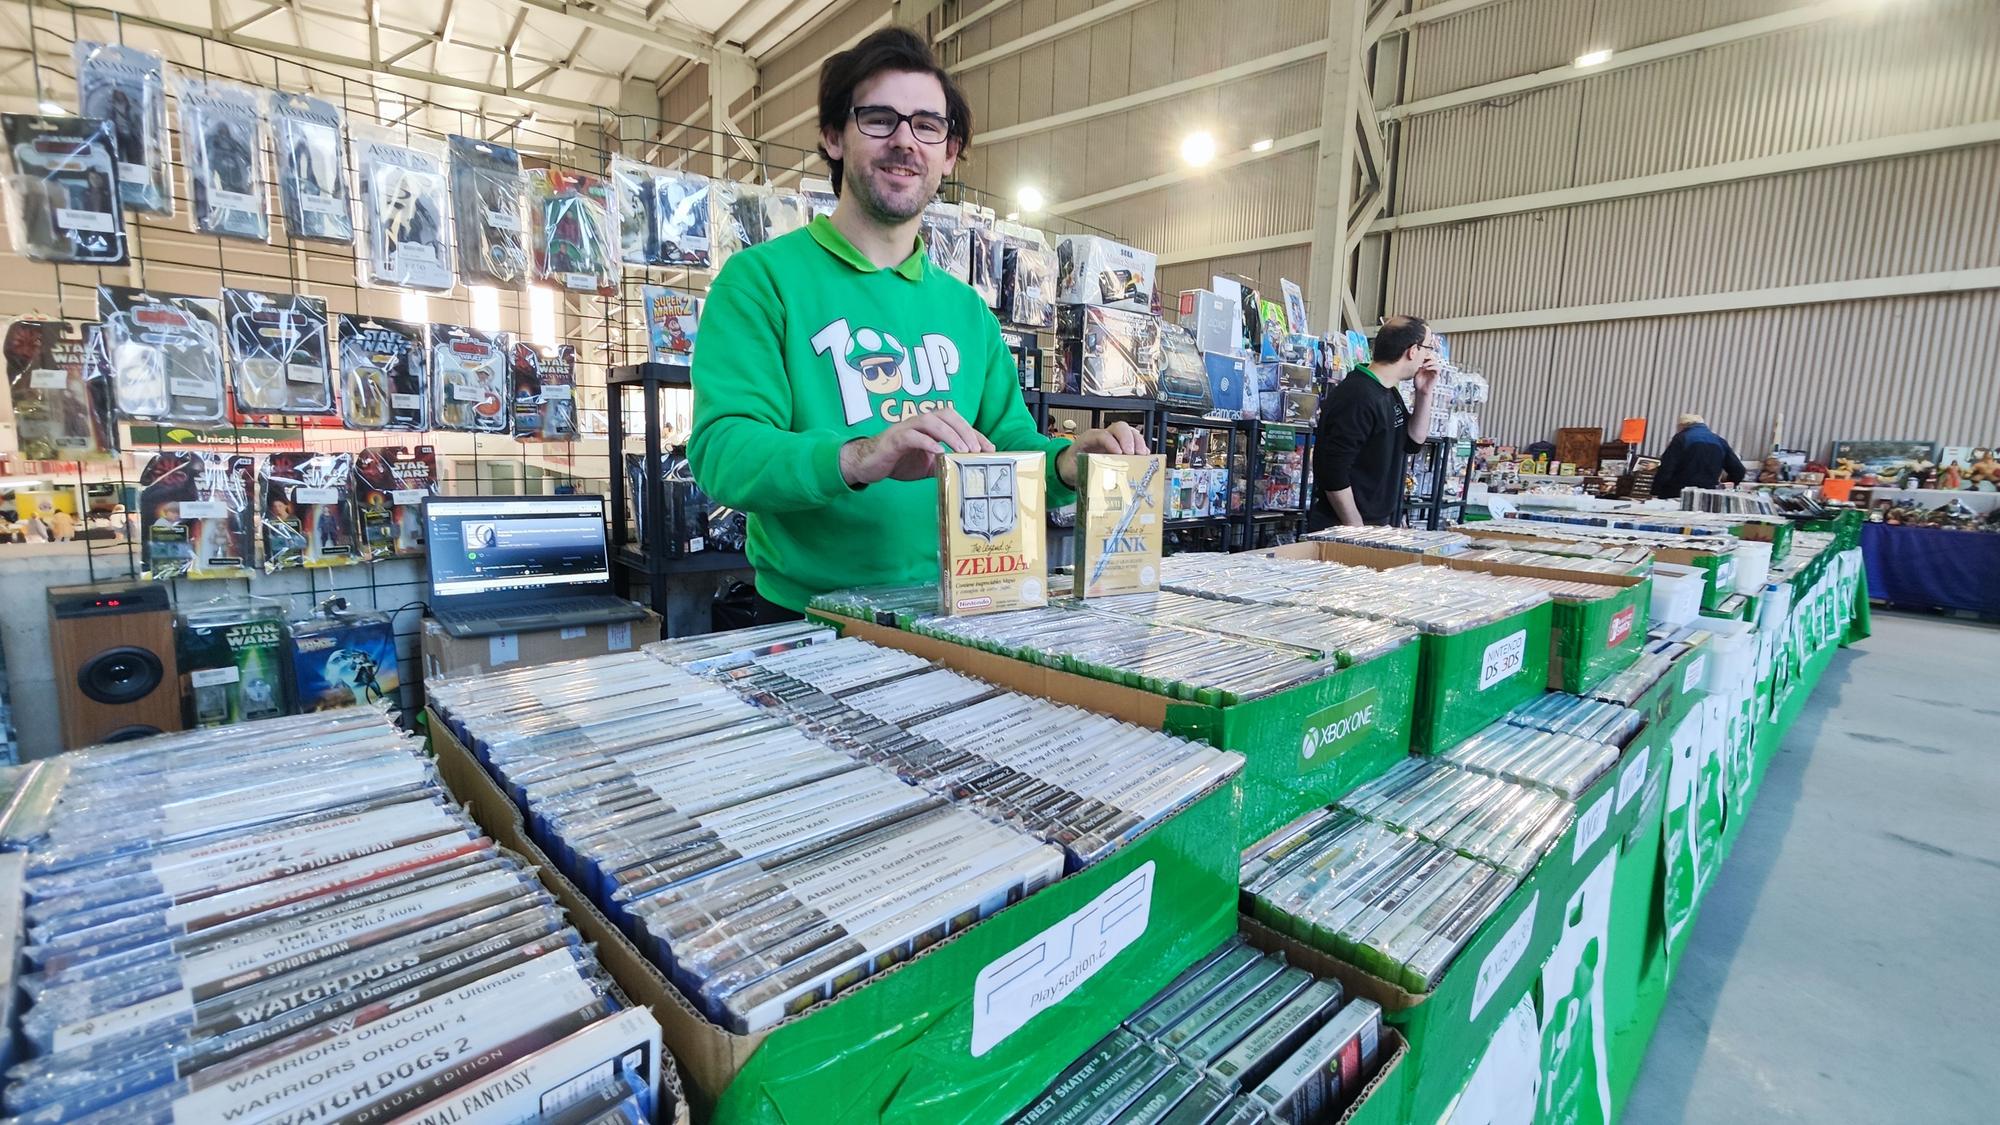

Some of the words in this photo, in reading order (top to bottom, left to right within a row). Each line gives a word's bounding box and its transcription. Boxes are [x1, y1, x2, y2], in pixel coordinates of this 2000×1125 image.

[653, 306, 683, 317] MARIO
[654, 296, 682, 307] SUPER
[363, 330, 403, 343] STAR
[538, 357, 567, 366] STAR
[539, 365, 570, 374] WARS
[902, 332, 961, 397] UP
[240, 434, 275, 444] Banco
[393, 460, 429, 470] STAR
[393, 469, 430, 479] WARS
[982, 540, 1004, 556] Legend
[1005, 541, 1014, 552] of
[1102, 536, 1148, 554] LINK
[955, 553, 1029, 577] ZELDA
[959, 598, 990, 608] Nintendo
[226, 624, 279, 637] STAR
[227, 634, 279, 647] WARS
[1487, 636, 1522, 662] NINTENDO
[1485, 661, 1498, 681] DS
[1501, 651, 1519, 672] 3DS
[1319, 715, 1352, 748] XBOX
[1352, 704, 1373, 732] ONE
[1015, 762, 1028, 770] The
[1029, 754, 1045, 765] King
[1052, 738, 1077, 753] Fighters
[1003, 767, 1012, 776] 2
[807, 816, 830, 830] KART
[190, 842, 250, 858] DRAGON
[252, 833, 285, 846] BALL
[305, 817, 361, 834] KAKAROT
[791, 870, 826, 888] Alone
[829, 863, 841, 873] in
[841, 855, 861, 868] the
[862, 845, 888, 859] Dark
[806, 881, 846, 902] Atelier
[848, 872, 868, 884] Iris
[881, 853, 915, 871] Grand
[914, 833, 964, 857] Phantasm
[826, 892, 862, 911] Atelier
[885, 867, 920, 886] Eternal
[921, 855, 949, 869] Mana
[894, 893, 907, 905] los
[907, 881, 935, 898] Juegos
[719, 892, 771, 916] PlayStation
[278, 931, 309, 945] THE
[317, 914, 366, 932] CREW
[732, 907, 786, 932] PlayStation
[226, 957, 257, 970] THE
[262, 934, 329, 959] WITCHER
[351, 915, 386, 931] WILD
[390, 903, 424, 919] HUNT
[266, 941, 350, 975] SPIDER-MAN
[1030, 953, 1096, 1008] PlayStation
[223, 1012, 317, 1051] Uncharted
[322, 1000, 339, 1013] 4:
[341, 992, 359, 1007] El
[360, 965, 437, 1000] Desenlace
[440, 956, 463, 971] del
[226, 1039, 351, 1092] WARRIORS
[356, 1005, 434, 1041] OROCHI
[444, 998, 454, 1006] 4
[457, 970, 526, 1000] Ultimate
[1226, 1007, 1254, 1031] POWER
[453, 1036, 473, 1055] 2
[222, 1059, 356, 1121] WARRIORS
[362, 1022, 445, 1063] OROCHI
[456, 1014, 467, 1024] 4
[357, 1086, 426, 1124] DELUXE
[433, 1048, 504, 1088] EDITION
[461, 1067, 533, 1121] FANTASY
[1014, 1094, 1058, 1125] STREET
[1100, 1051, 1112, 1063] 2
[1091, 1068, 1127, 1099] ASSAULT
[1110, 1077, 1145, 1110] ASSAULT
